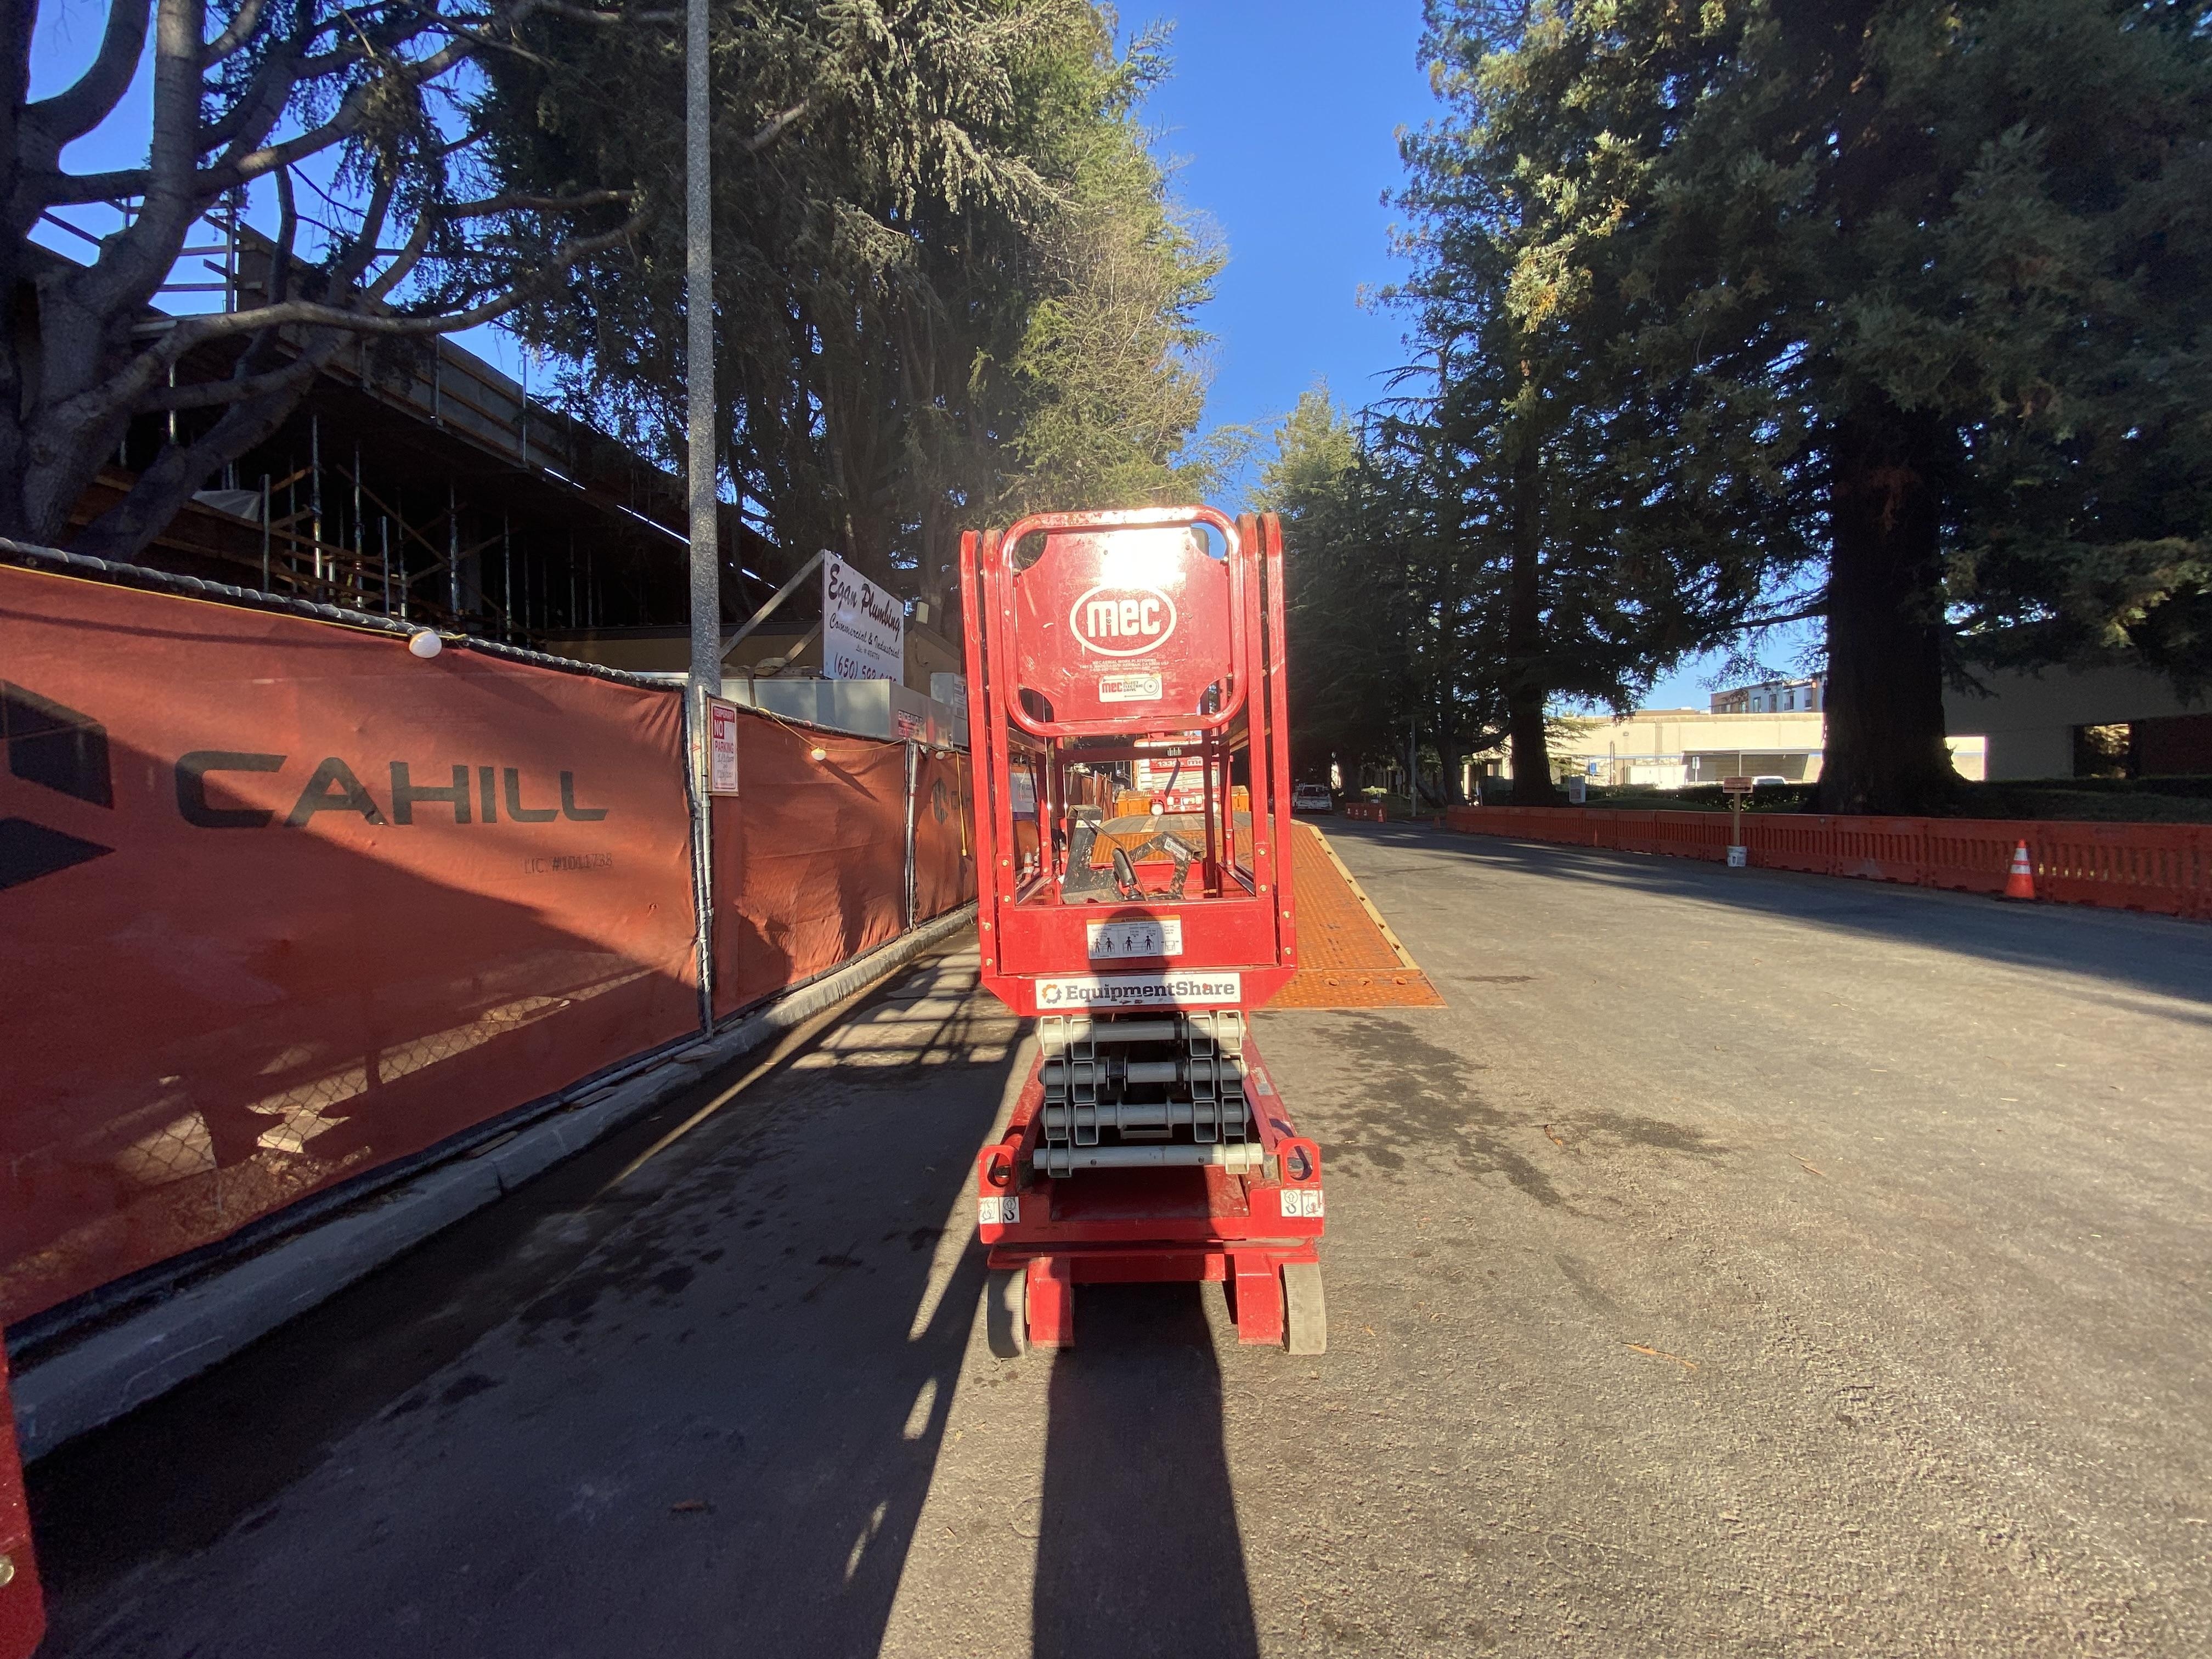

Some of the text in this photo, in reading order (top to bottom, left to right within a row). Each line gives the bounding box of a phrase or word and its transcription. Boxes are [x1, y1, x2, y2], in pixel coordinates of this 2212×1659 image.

[828, 563, 901, 642] Egan Plumbing
[830, 613, 867, 643] Commercial
[868, 632, 873, 645] &
[874, 635, 899, 658] Industrial
[834, 652, 858, 680] (650)
[714, 719, 723, 736] NO
[715, 741, 733, 754] PARKING
[176, 750, 608, 828] CAHILL
[1065, 980, 1234, 1002] EquipmentShare
